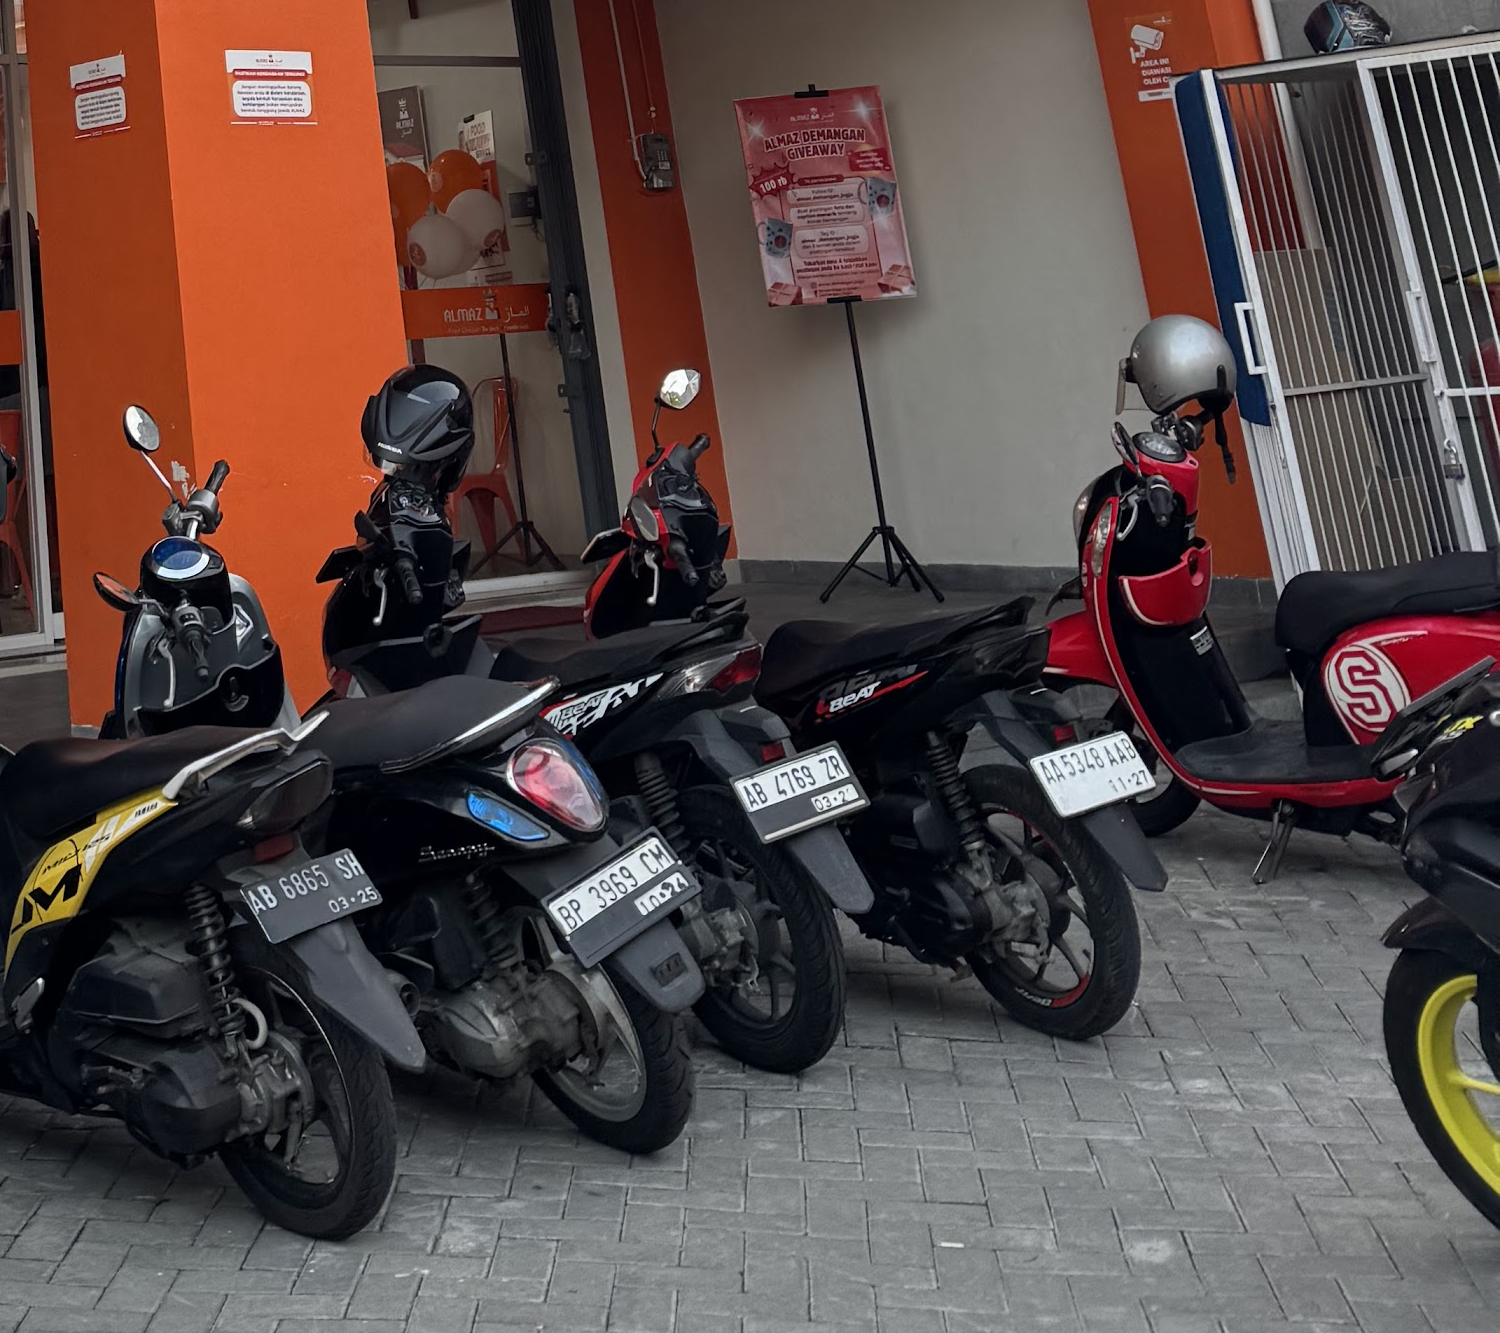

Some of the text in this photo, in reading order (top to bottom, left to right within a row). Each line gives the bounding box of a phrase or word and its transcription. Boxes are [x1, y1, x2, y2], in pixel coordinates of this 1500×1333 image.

[1141, 66, 1172, 76] DIAWASI
[1143, 76, 1162, 85] OLEH
[764, 128, 865, 152] ALMAZ DEMANGAN
[786, 143, 845, 161] GIVEAWAY
[759, 176, 787, 193] 100 rb
[444, 307, 483, 323] ALMAZ
[1335, 650, 1397, 728] S
[1040, 738, 1137, 785] AA 5348 AAB
[743, 755, 845, 808] AB 4769 ZR
[247, 852, 365, 915] AB 6865 SH
[557, 844, 671, 930] BP 3969 CM
